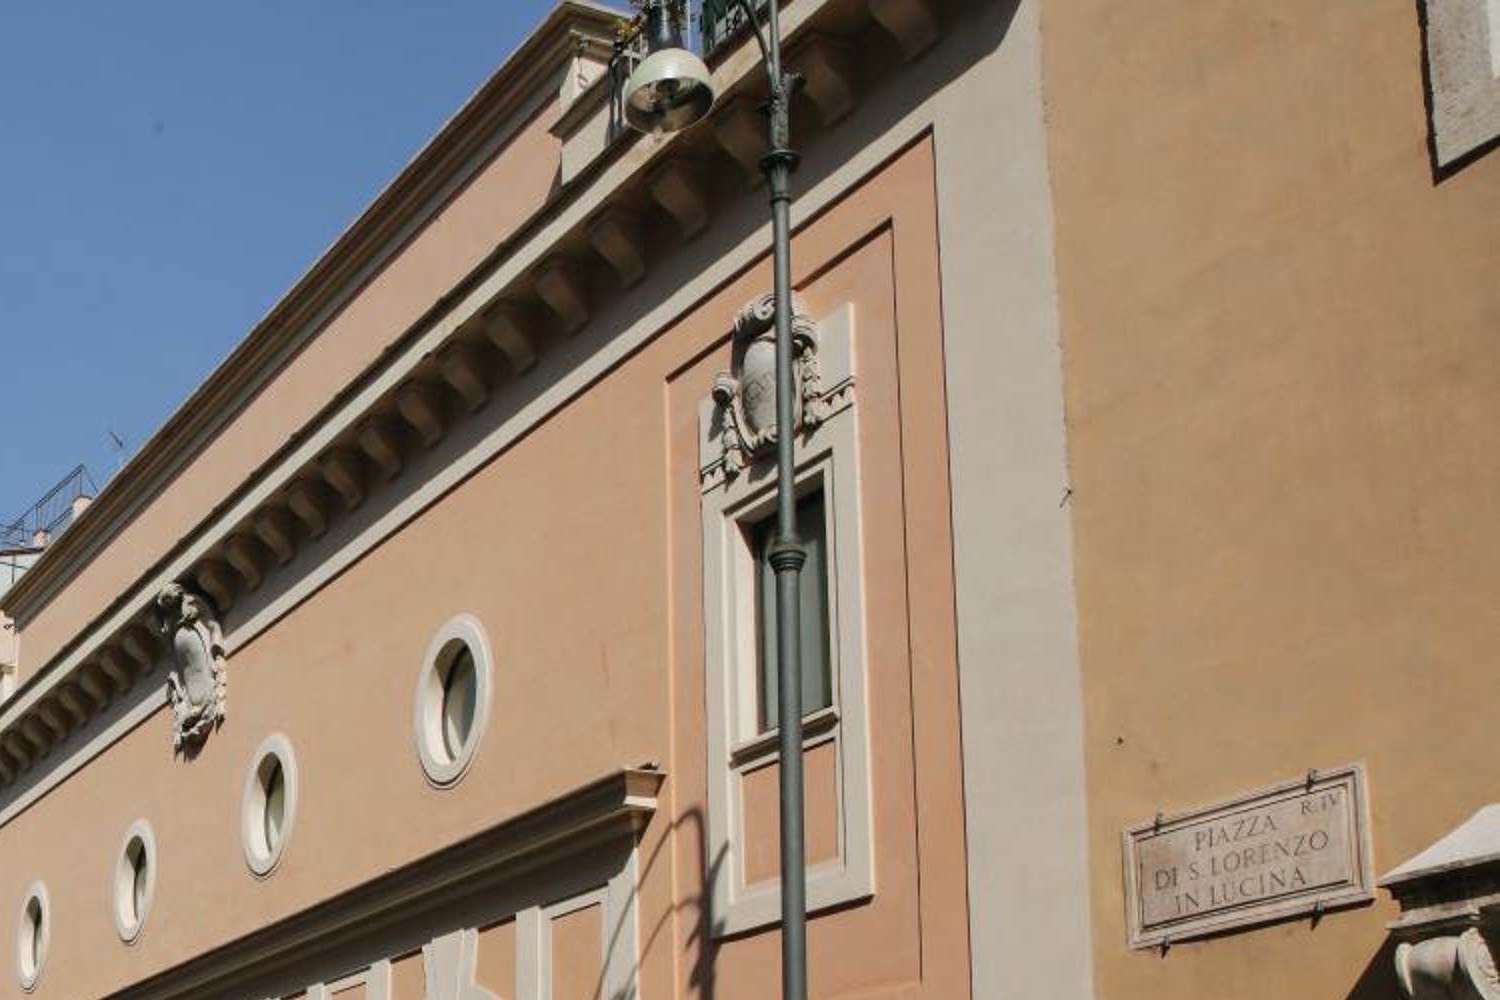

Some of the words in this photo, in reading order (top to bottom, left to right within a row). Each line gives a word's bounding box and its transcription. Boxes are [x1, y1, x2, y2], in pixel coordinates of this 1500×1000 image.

[1194, 814, 1277, 851] PIAZZA
[1155, 866, 1178, 891] DI
[1210, 829, 1330, 876] LORENZO
[1174, 892, 1200, 914] IN
[1210, 864, 1308, 906] LUCINA
